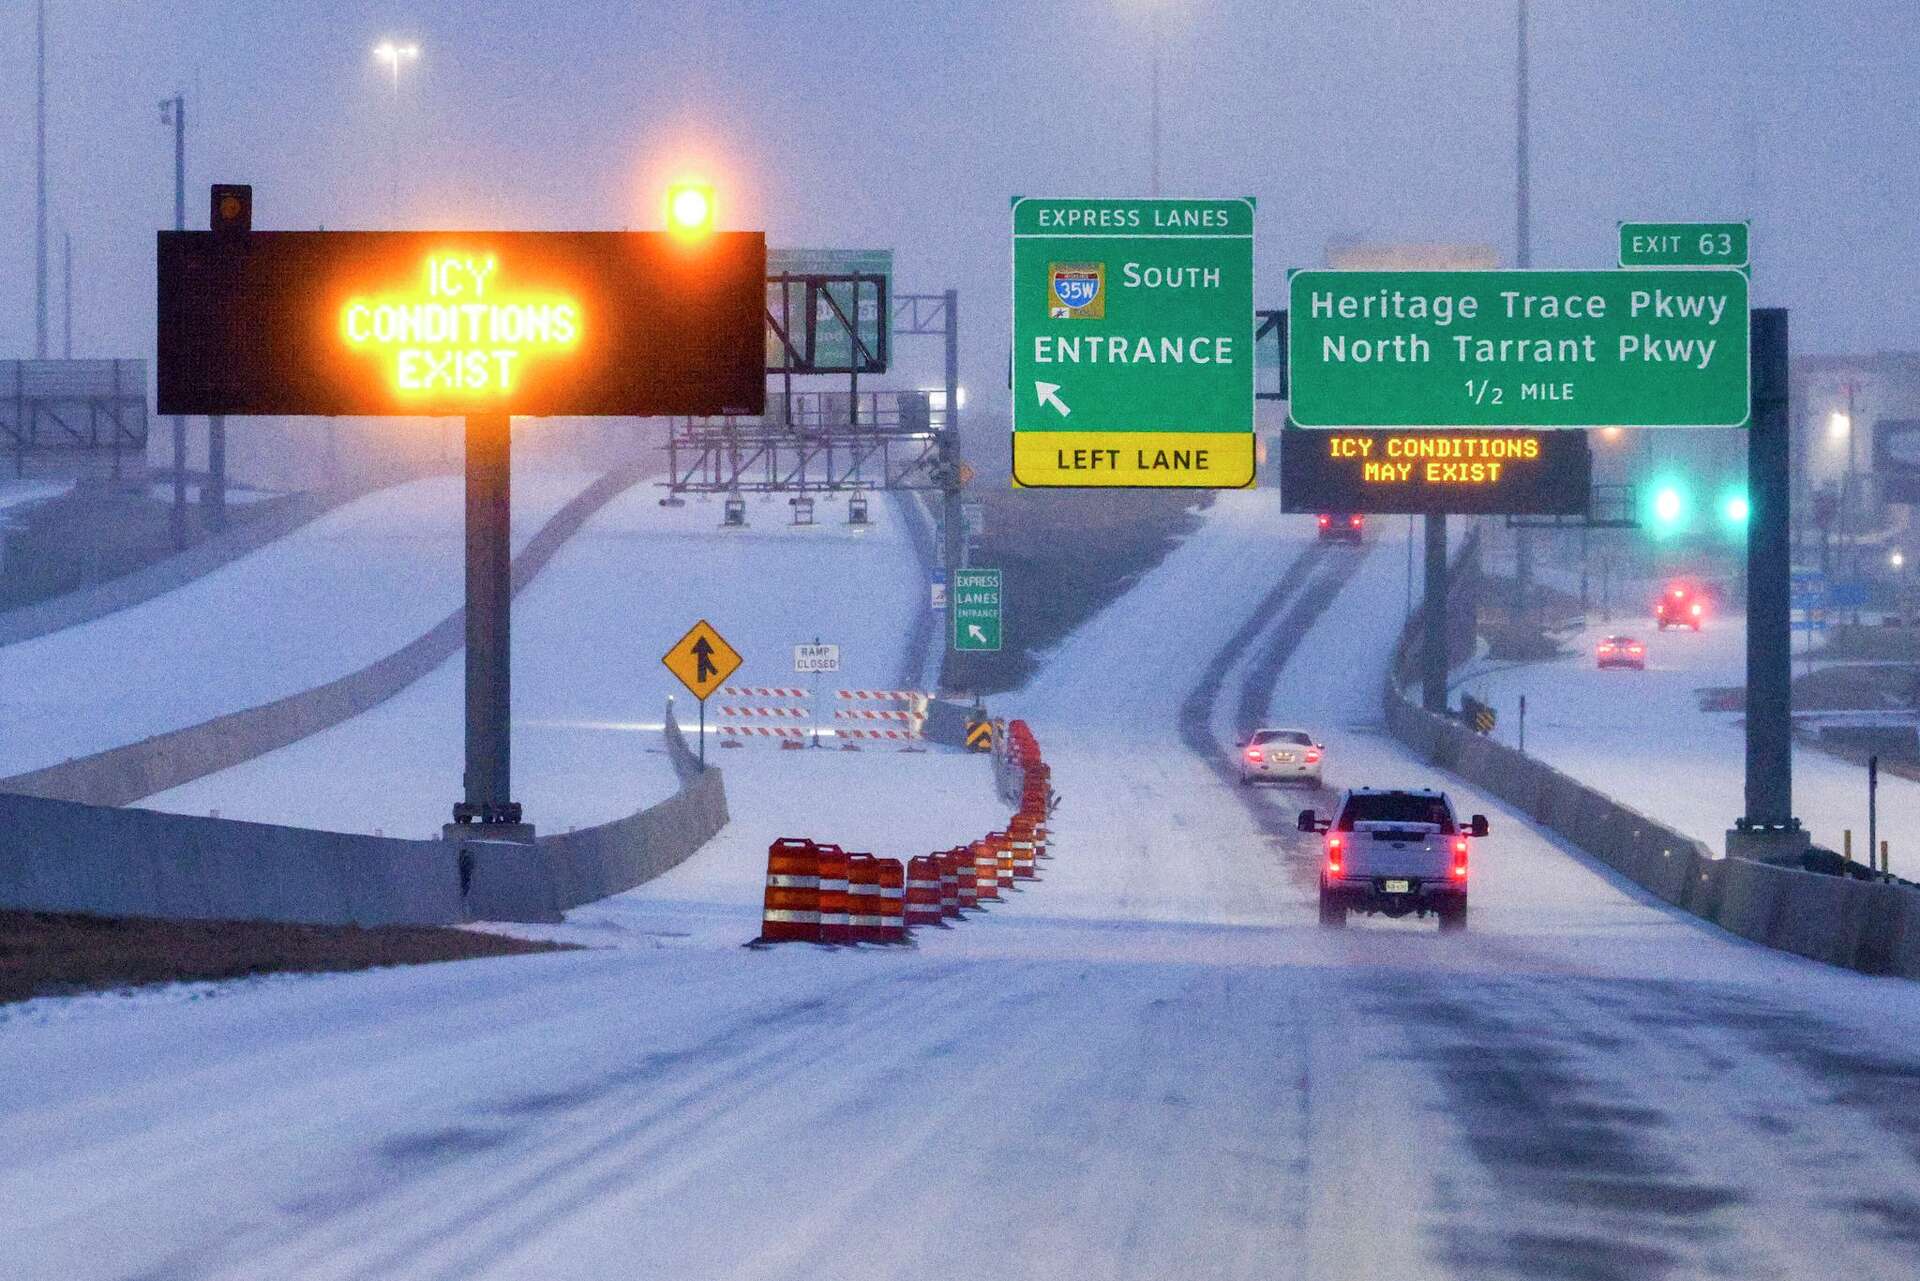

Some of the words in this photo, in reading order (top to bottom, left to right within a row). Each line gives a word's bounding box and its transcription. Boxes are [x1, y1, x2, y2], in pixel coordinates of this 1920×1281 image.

[1039, 209, 1140, 227] EXPRESS
[1154, 209, 1230, 227] LANES
[1632, 235, 1681, 254] EXIT
[1698, 233, 1733, 255] 63
[428, 256, 495, 297] ICY
[1060, 281, 1095, 299] 35W
[1311, 289, 1479, 326] Heritage
[1500, 291, 1606, 319] Trace
[1630, 289, 1728, 325] Pkwy
[346, 303, 577, 343] CONDITIONS
[1034, 336, 1233, 364] ENTRANCE
[1322, 334, 1430, 363] North
[1453, 335, 1597, 363] Tarrant
[1619, 333, 1717, 369] Pkwy
[397, 350, 518, 390] EXIST
[1464, 380, 1504, 406] 1/2
[1521, 383, 1575, 401] MILE
[1330, 438, 1373, 458] ICY
[1387, 438, 1540, 458] CONDITIONS
[1057, 449, 1121, 470] LEFT
[1138, 449, 1210, 470] LANE
[1364, 462, 1411, 482] MAY
[1426, 462, 1502, 482] EXIST
[956, 576, 999, 588] EXPRESS
[957, 593, 999, 604] LANES
[800, 647, 830, 656] RAMP
[797, 658, 836, 669] CLOSED
